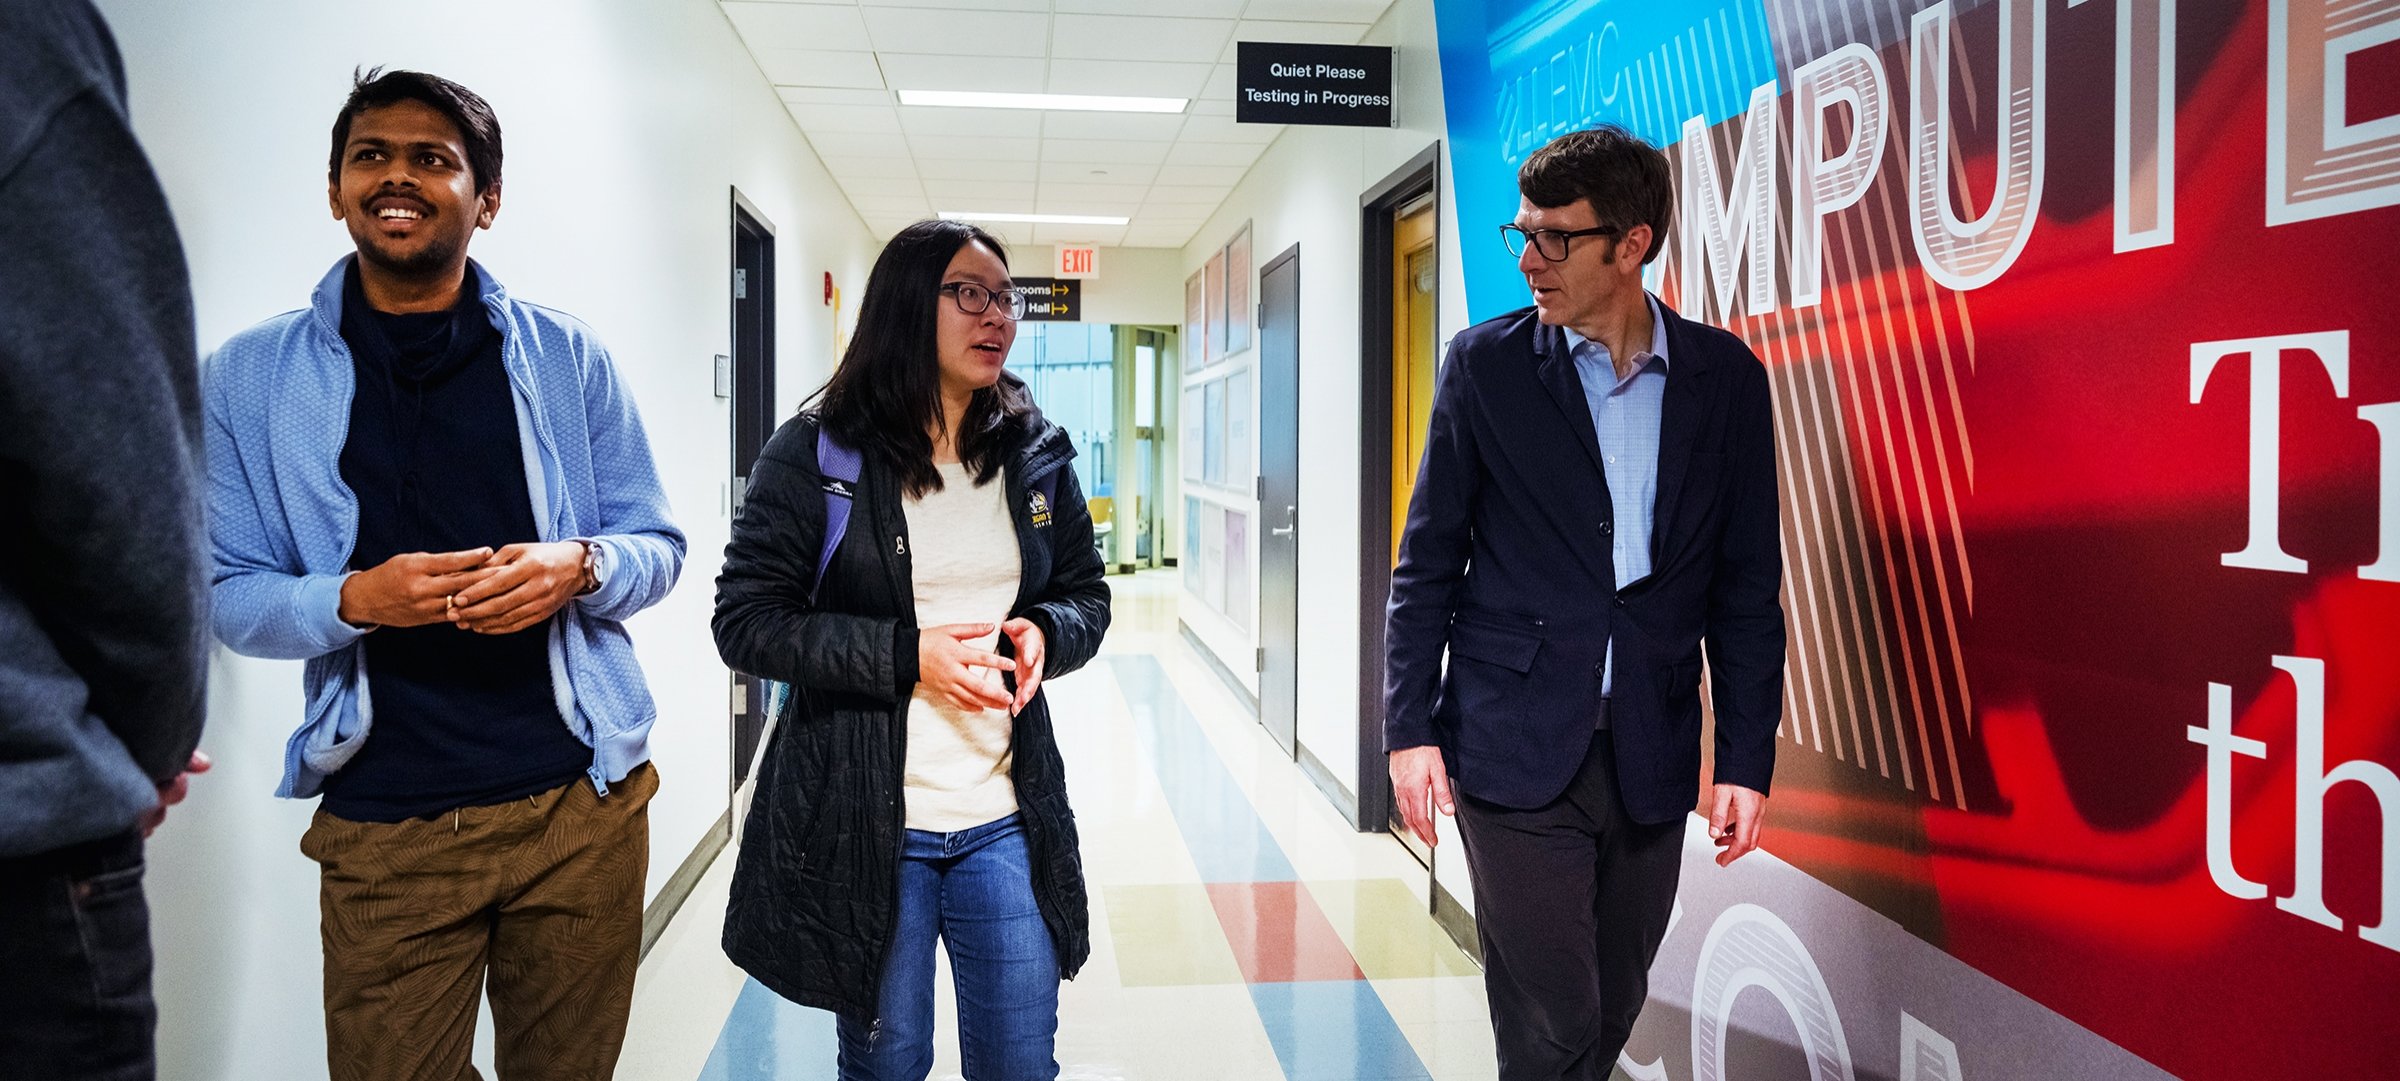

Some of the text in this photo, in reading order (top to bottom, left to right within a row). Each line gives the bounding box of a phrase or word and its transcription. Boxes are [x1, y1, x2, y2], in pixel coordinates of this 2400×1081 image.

[1270, 63, 1366, 79] Quiet Please
[1245, 88, 1390, 108] Testing in Progress
[1062, 249, 1093, 273] EXIT
[1016, 286, 1051, 295] rooms
[1028, 302, 1050, 313] Hall
